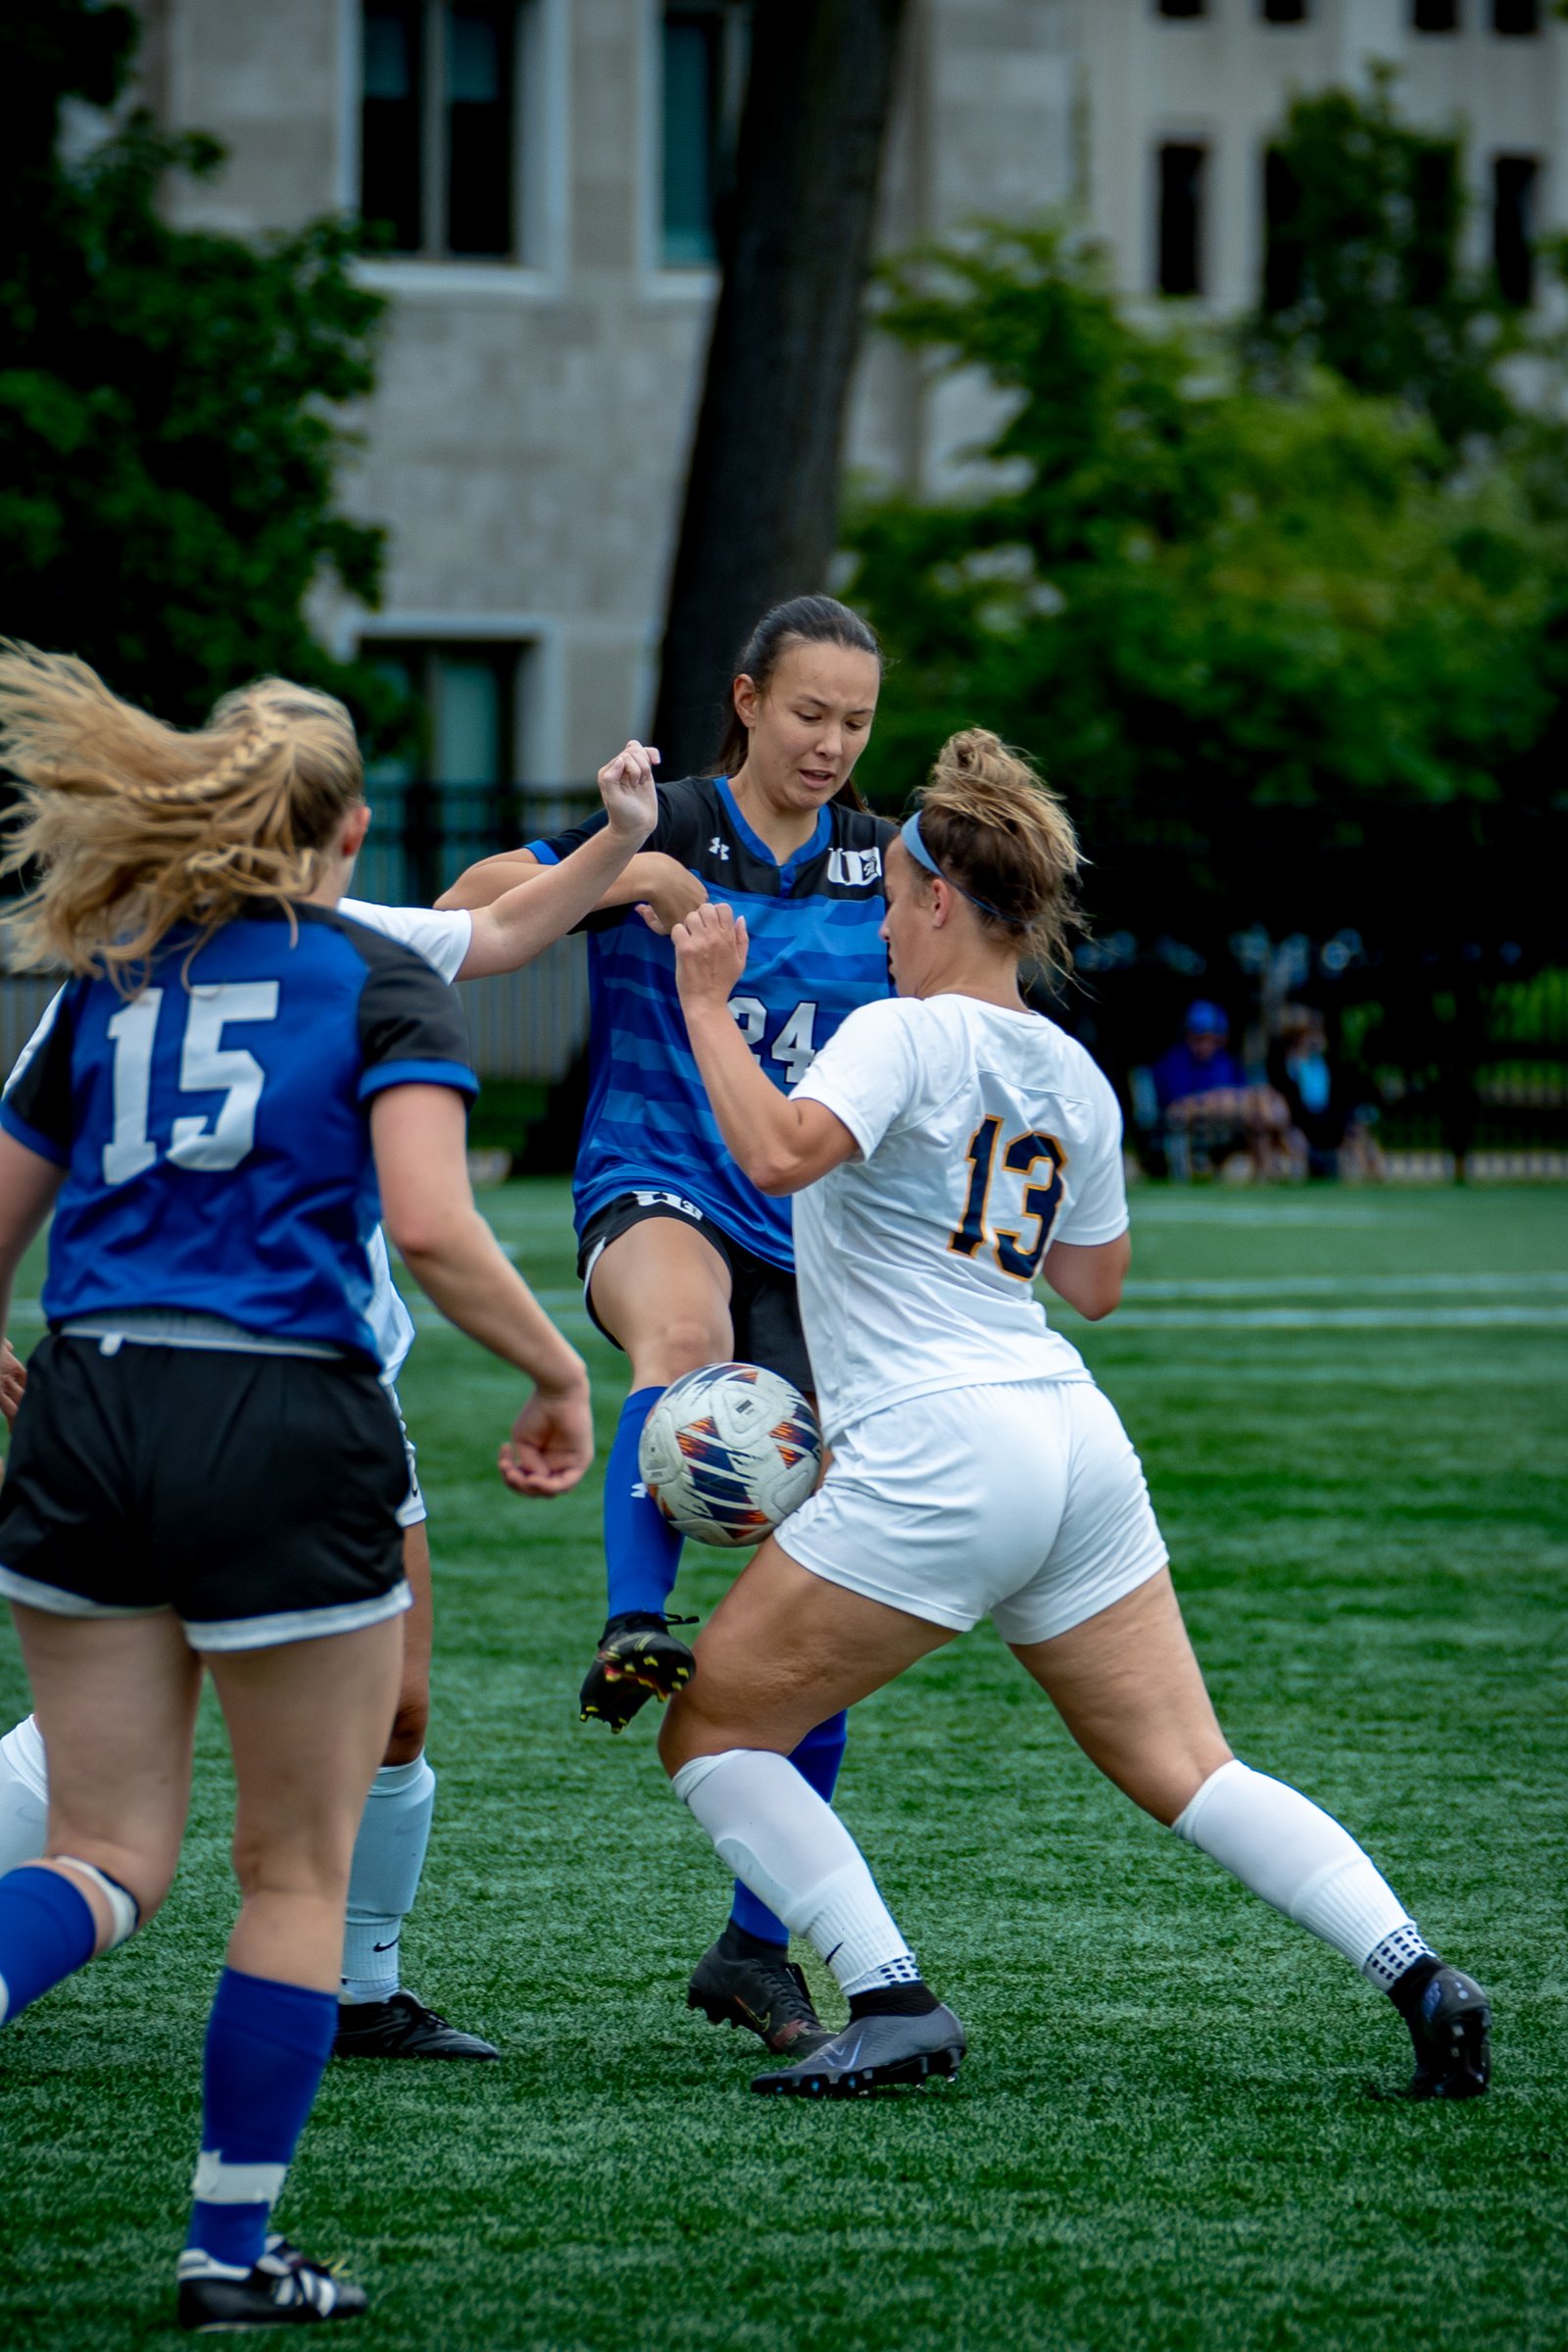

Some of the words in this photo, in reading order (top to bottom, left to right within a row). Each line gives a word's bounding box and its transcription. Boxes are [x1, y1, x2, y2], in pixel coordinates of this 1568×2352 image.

[104, 981, 279, 1185] 15
[727, 997, 816, 1084] 24
[945, 1113, 1068, 1282] 13
